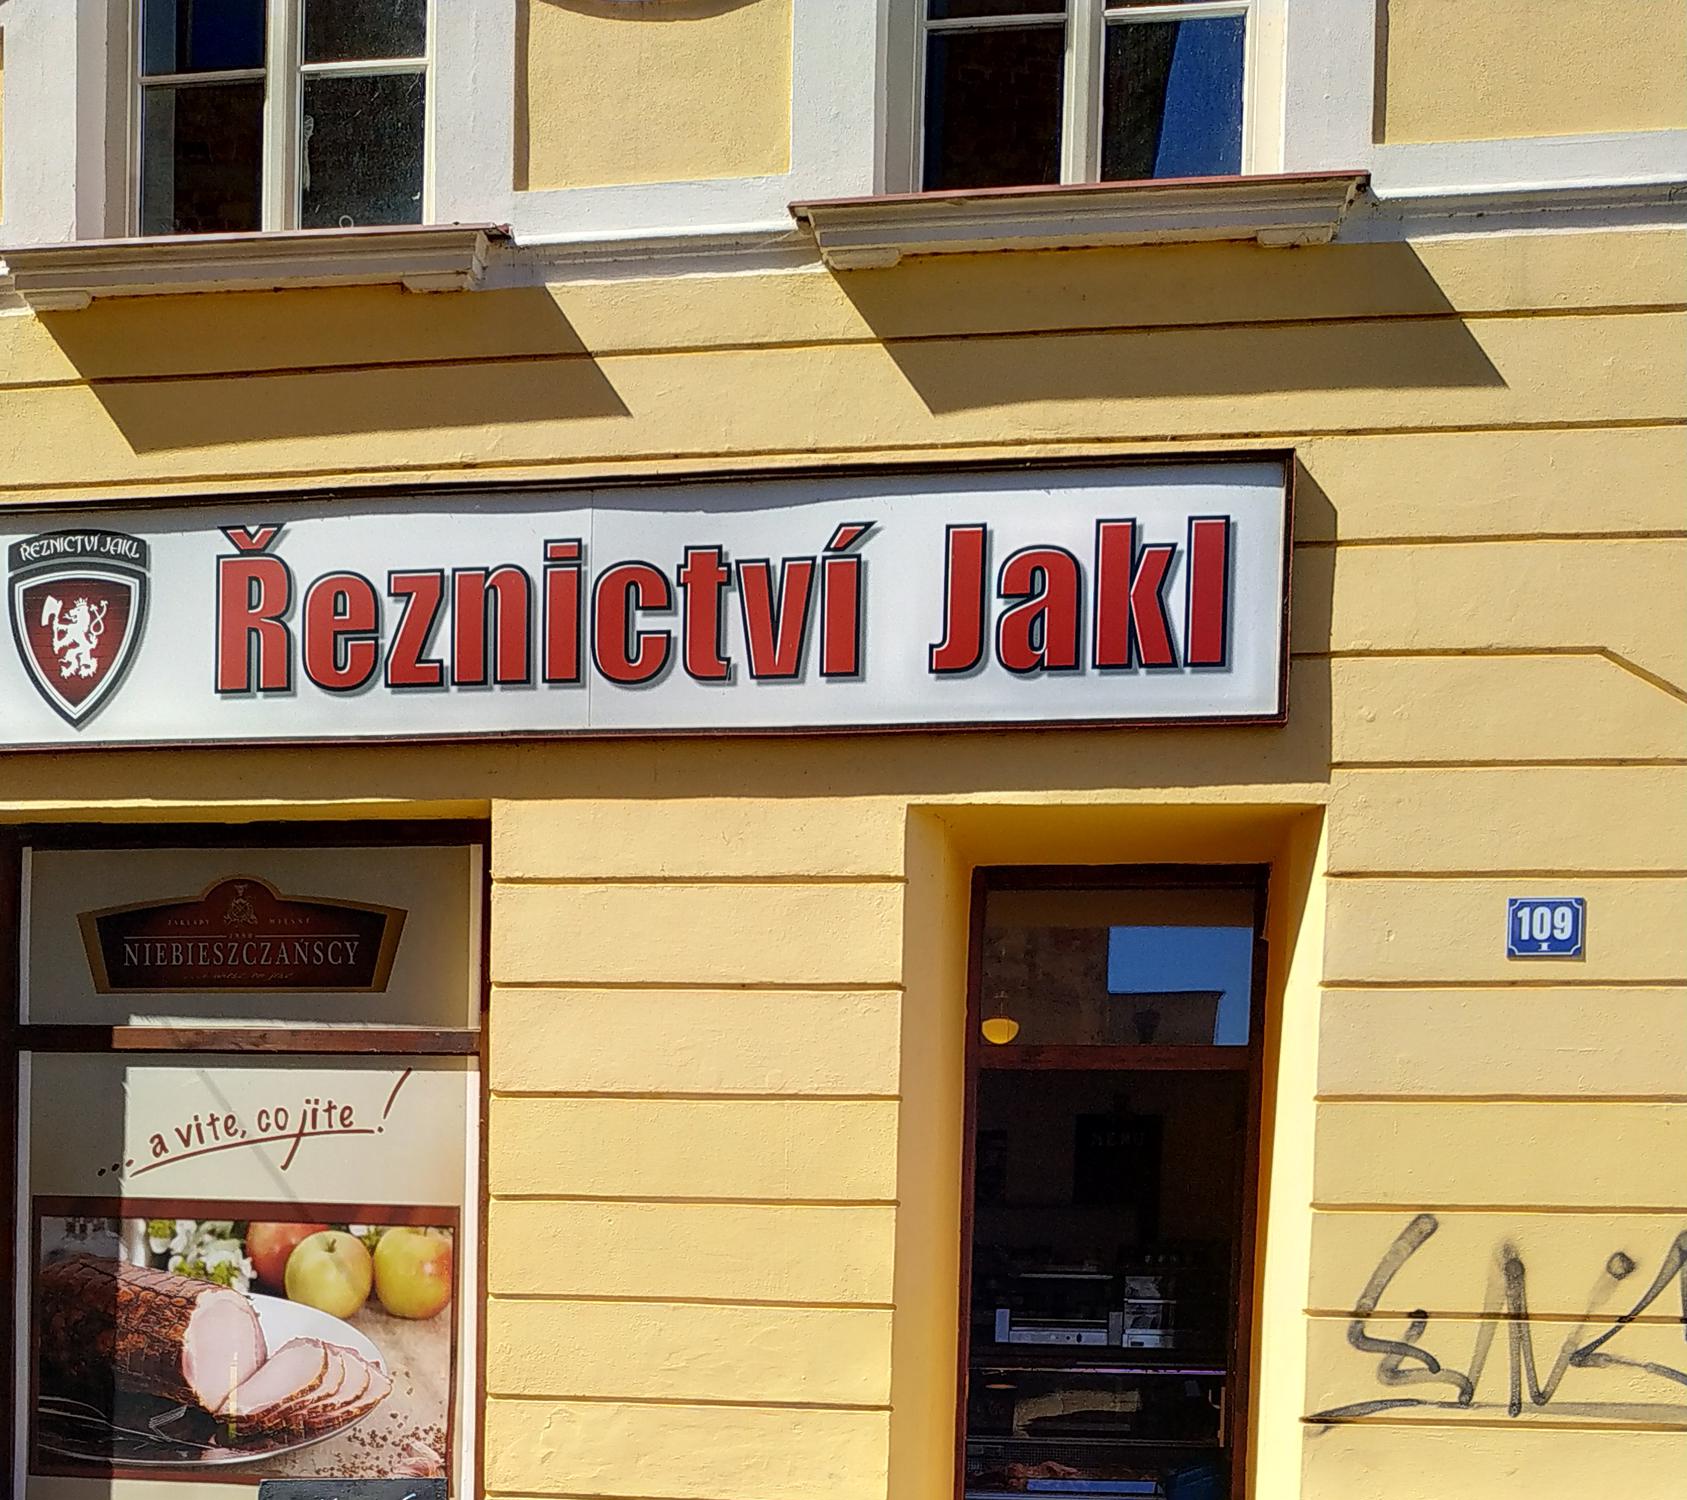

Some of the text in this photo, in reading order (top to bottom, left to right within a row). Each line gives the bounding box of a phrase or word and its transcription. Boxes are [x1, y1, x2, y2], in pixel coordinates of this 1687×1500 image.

[19, 533, 140, 561] ŘEZNICTVÍ JAKL
[215, 514, 1232, 694] Řeznictví Jakl
[1517, 905, 1573, 941] 109
[123, 938, 360, 967] NIEBIESZCZAŃSCY
[148, 1133, 169, 1158] a
[256, 1106, 289, 1132] co
